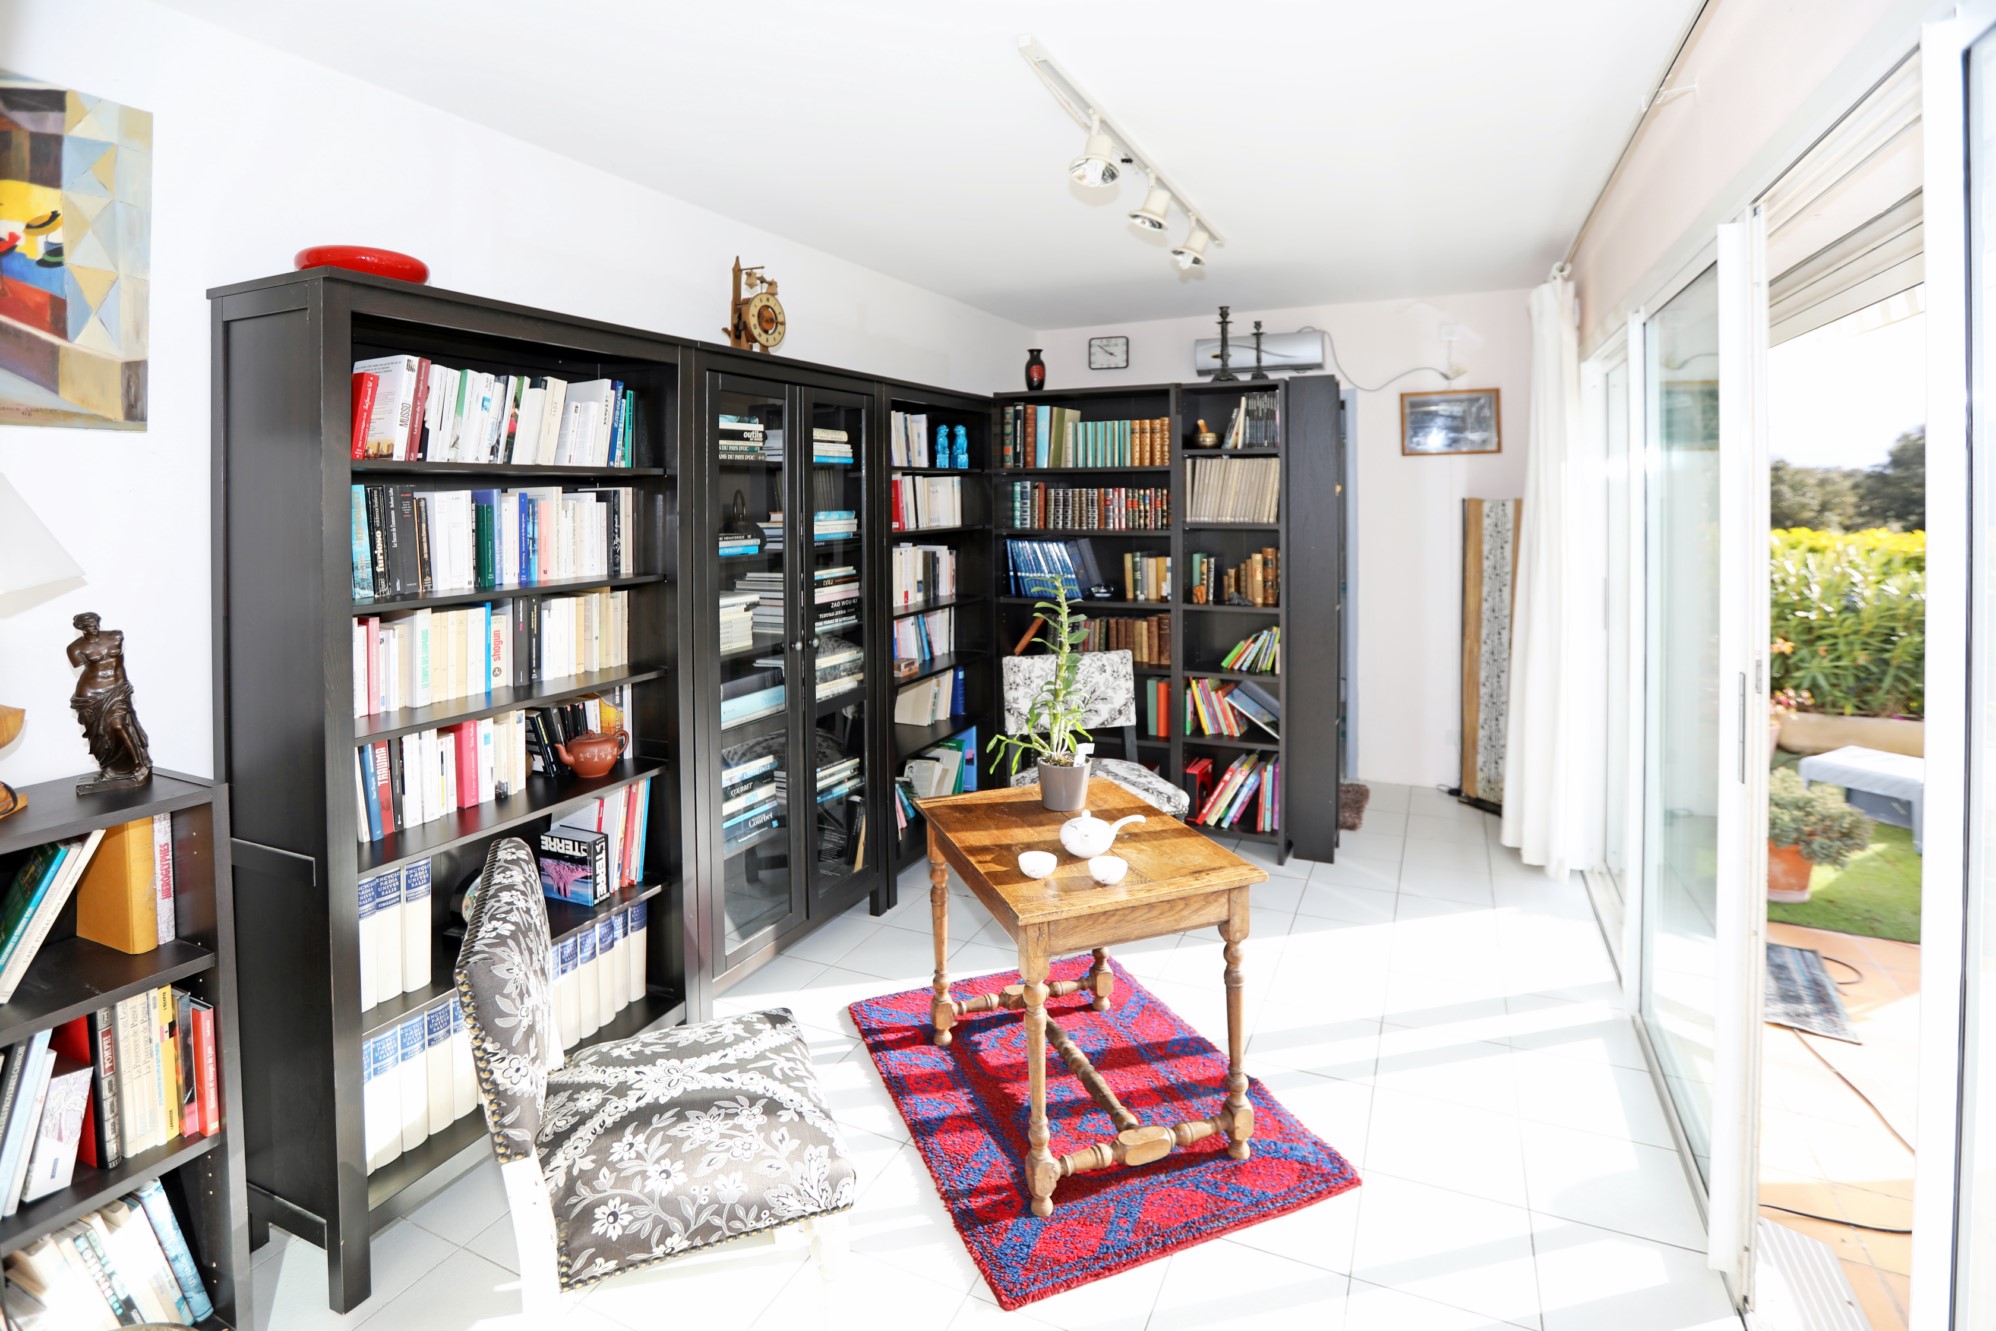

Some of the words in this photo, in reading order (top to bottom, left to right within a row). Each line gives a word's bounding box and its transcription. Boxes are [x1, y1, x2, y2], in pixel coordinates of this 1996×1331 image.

[398, 402, 411, 427] MUSSO
[743, 430, 763, 440] outils
[374, 530, 385, 572] furioso
[830, 600, 841, 608] ZAO
[492, 629, 503, 662] shogun
[375, 747, 389, 787] TRAUMA
[730, 782, 753, 796] COURBET
[748, 812, 774, 828] Courbet
[105, 1035, 114, 1068] POMPEI
